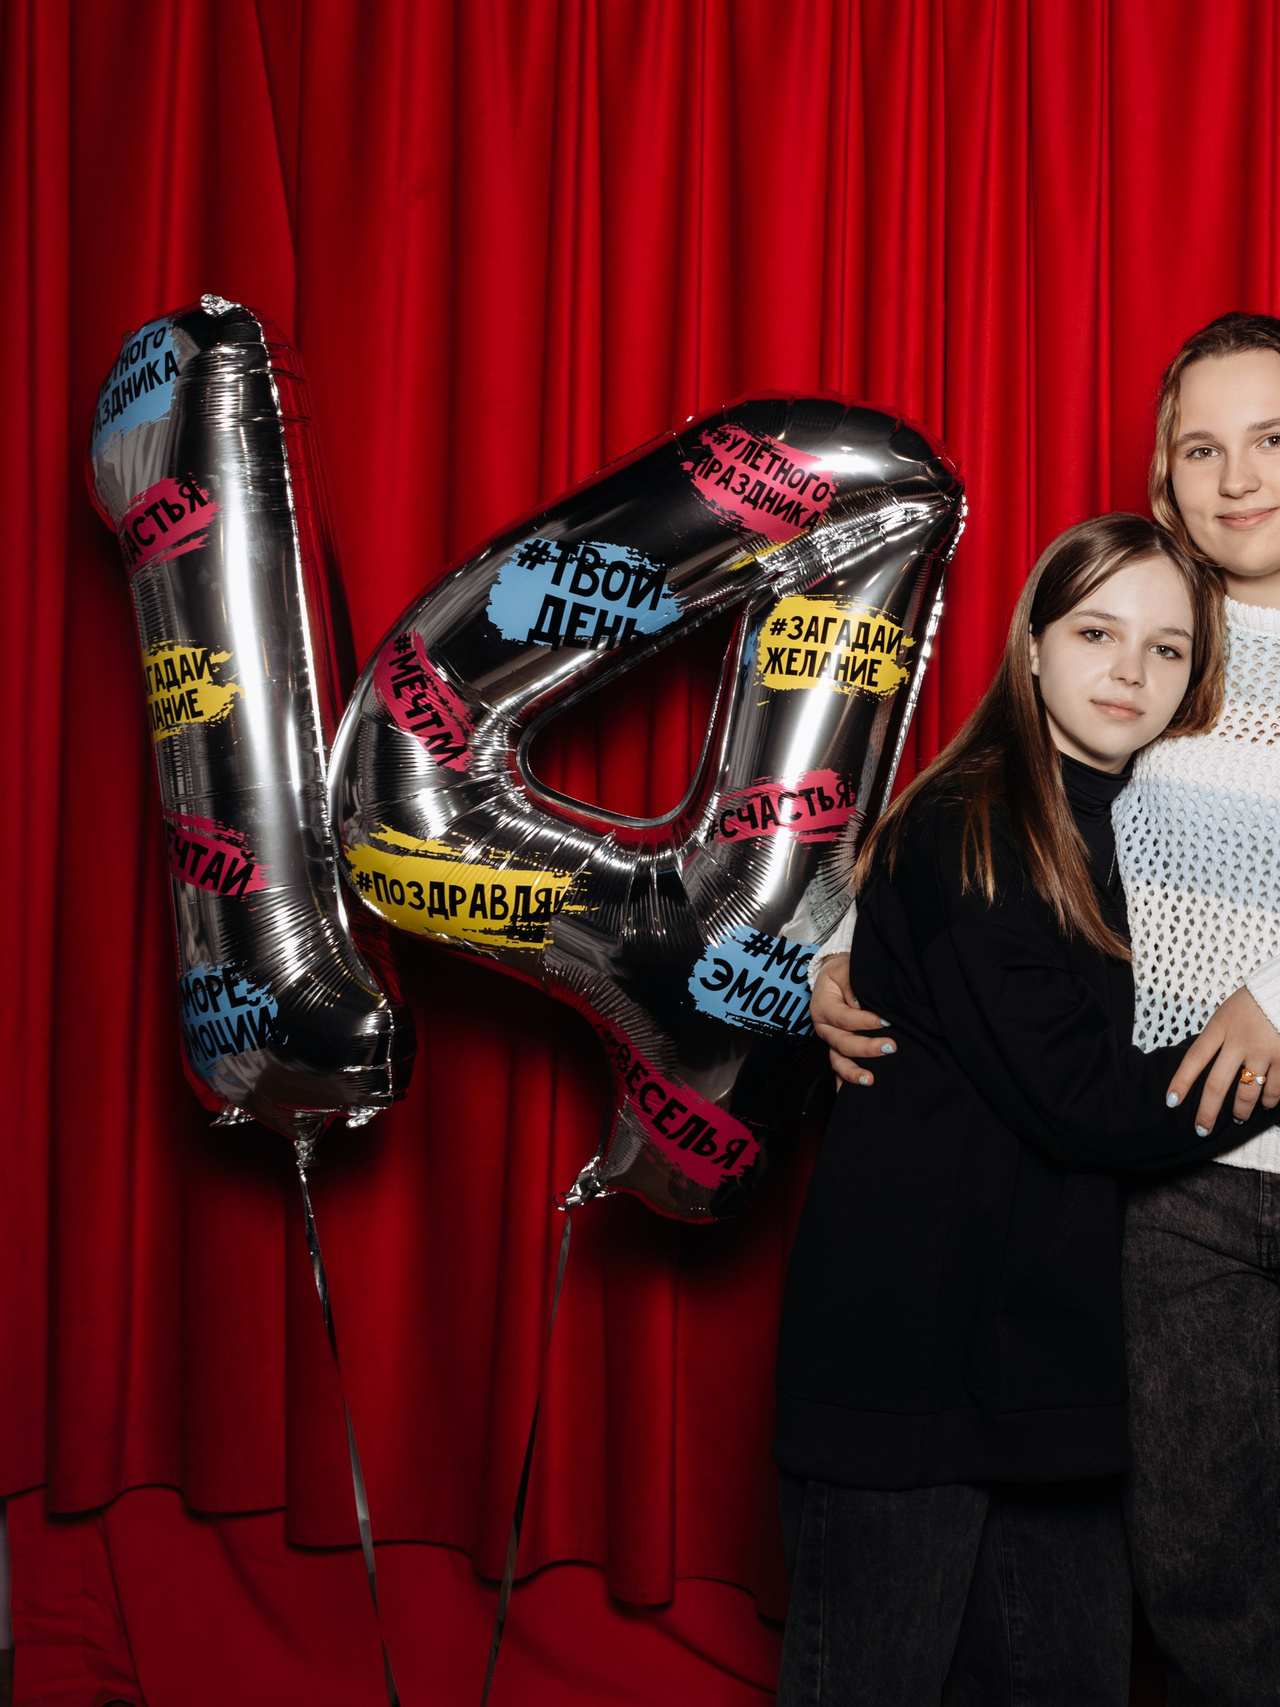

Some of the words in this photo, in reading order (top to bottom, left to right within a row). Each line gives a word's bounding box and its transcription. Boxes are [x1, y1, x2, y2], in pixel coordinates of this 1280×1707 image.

[121, 480, 208, 567] АСТЬЯ
[691, 452, 823, 532] ПРАЗДНИКА
[526, 593, 647, 651] ДЕНЬ
[763, 647, 882, 688] ЖЕЛАНИЕ
[705, 779, 856, 843] #СЧАСТЬЯ
[742, 931, 815, 993] #МО
